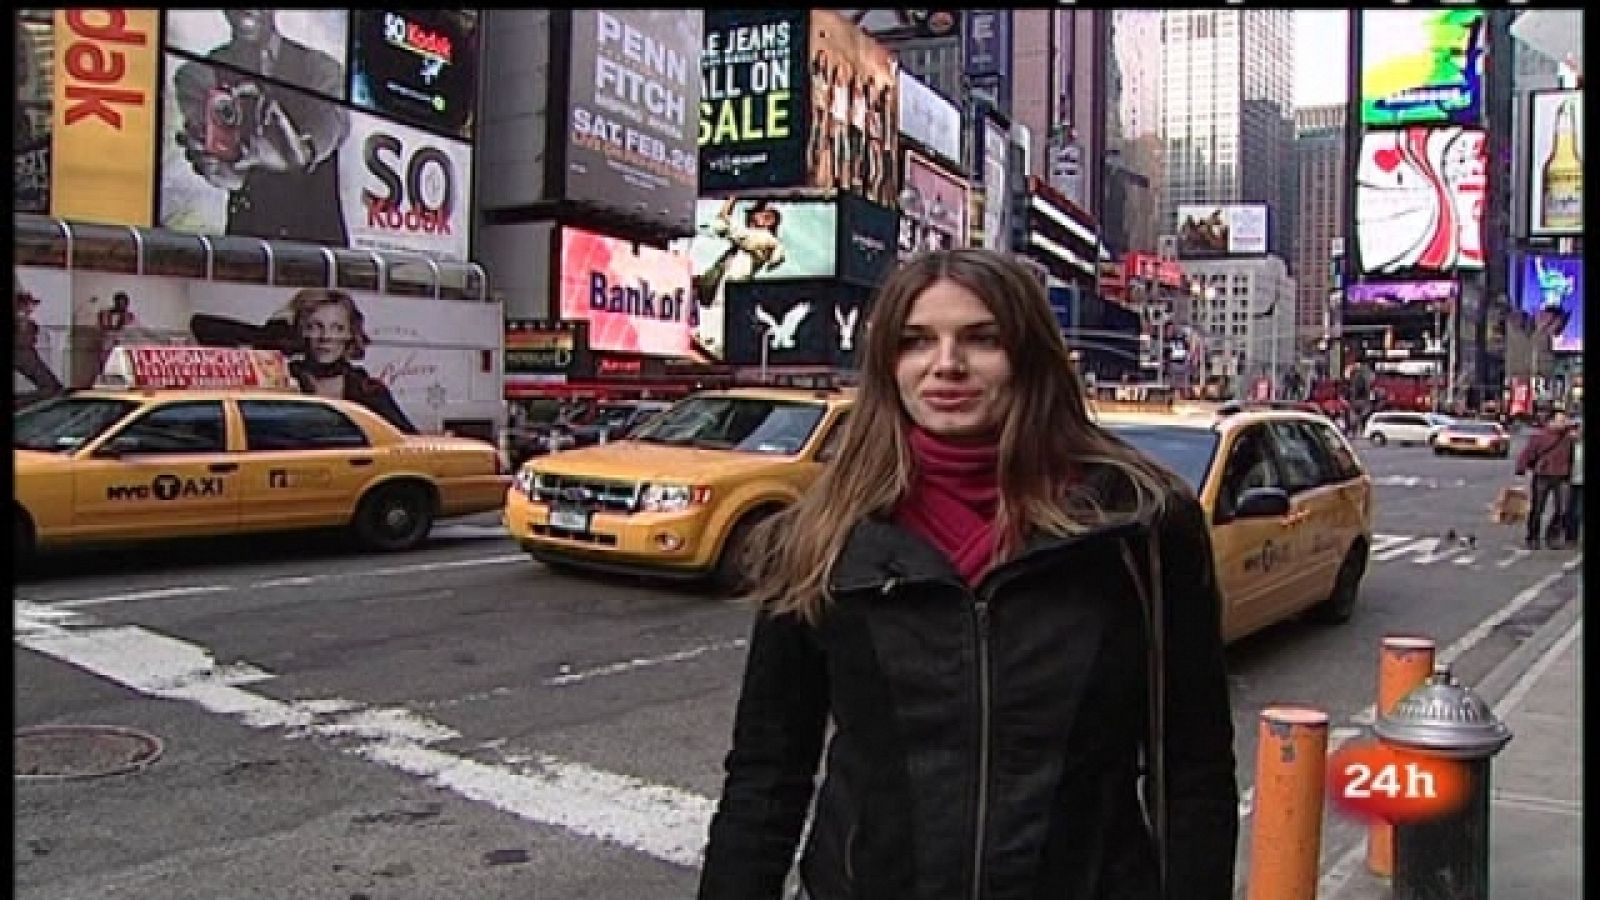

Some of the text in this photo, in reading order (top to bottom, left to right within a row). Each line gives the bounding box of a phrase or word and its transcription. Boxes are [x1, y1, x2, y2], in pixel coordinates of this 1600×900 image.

[597, 11, 686, 86] PENN
[596, 54, 686, 125] FITCH
[752, 59, 791, 93] ON
[697, 90, 791, 146] SALE
[362, 133, 454, 214] SO
[367, 197, 451, 235] Kodak
[589, 271, 656, 318] Bank
[659, 286, 685, 322] of
[153, 475, 224, 500] TAXI
